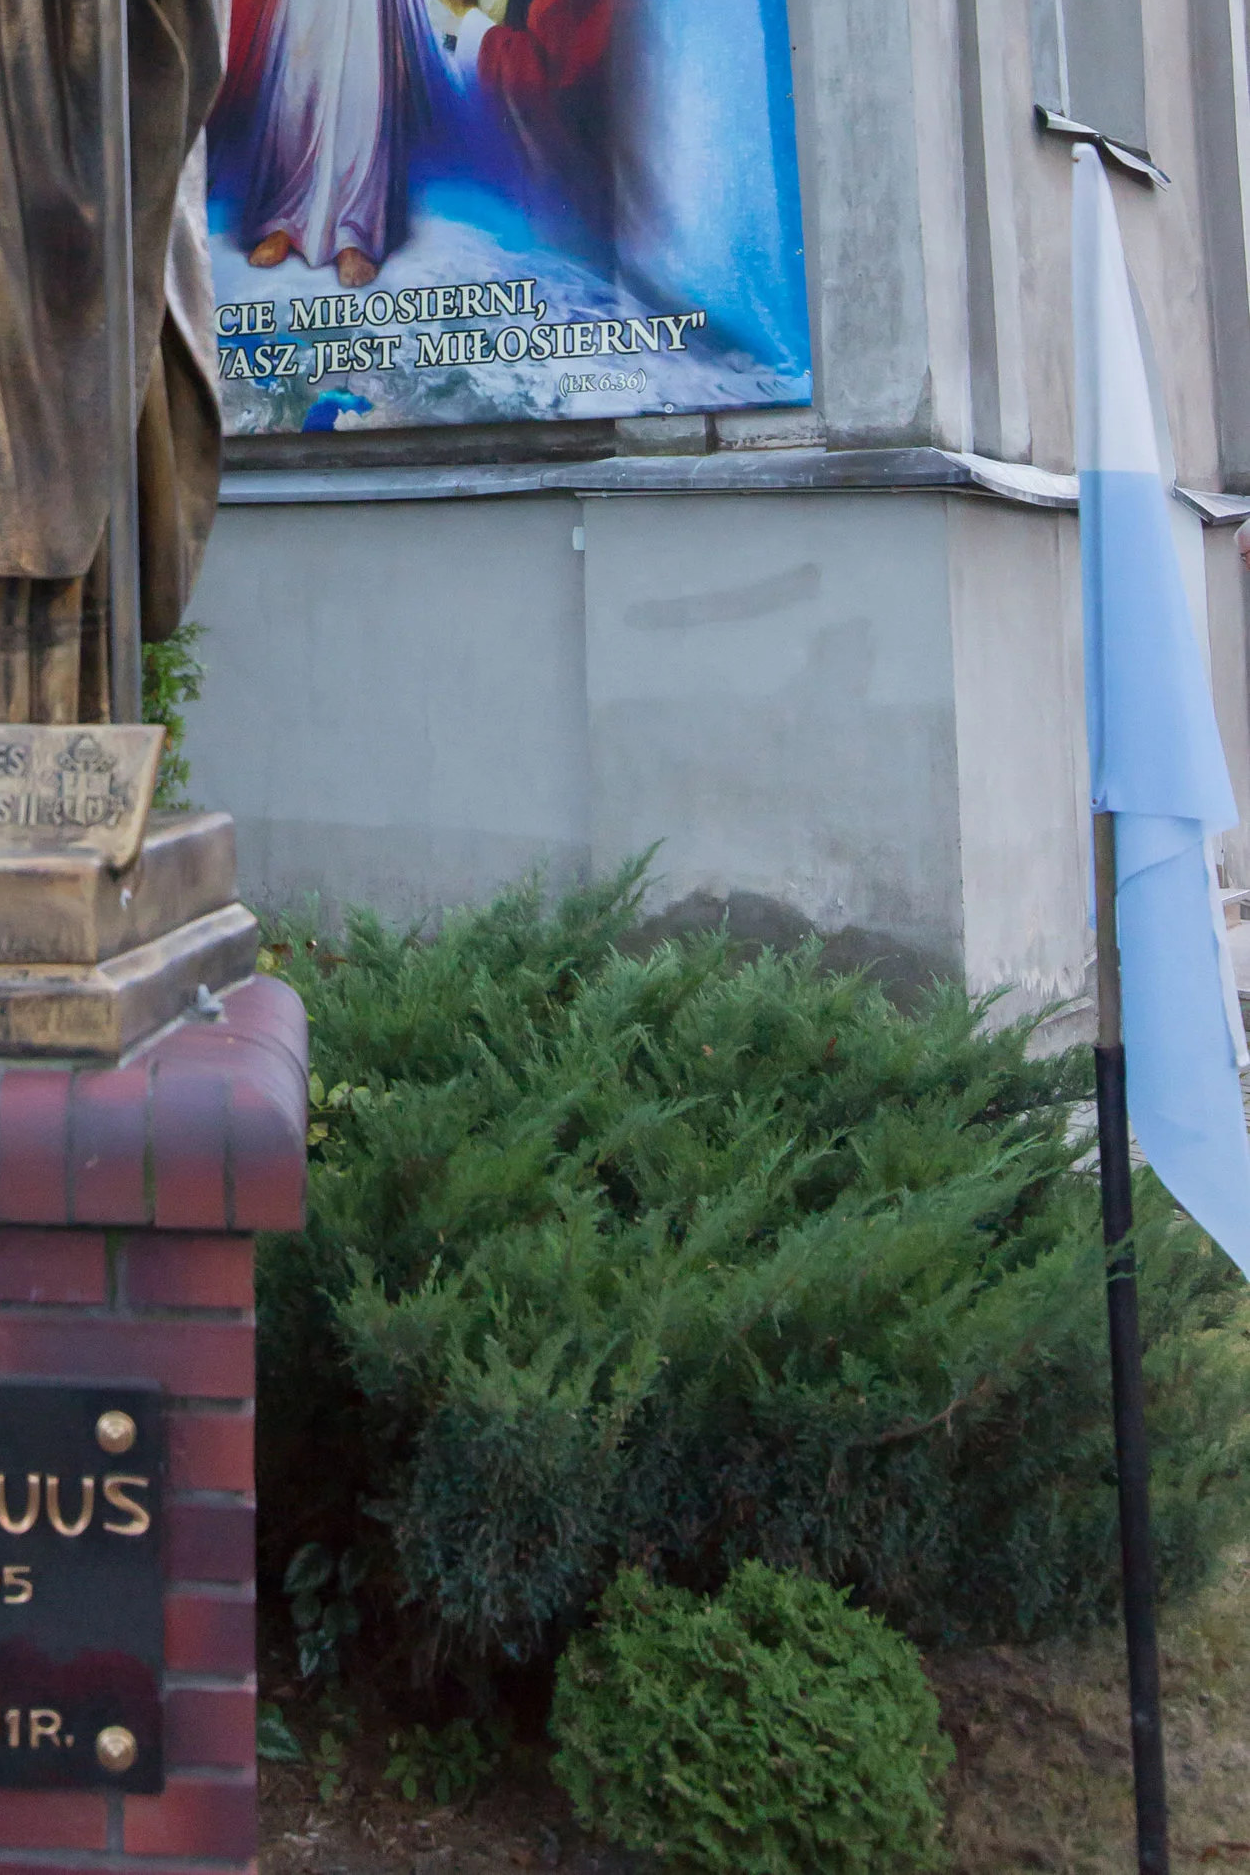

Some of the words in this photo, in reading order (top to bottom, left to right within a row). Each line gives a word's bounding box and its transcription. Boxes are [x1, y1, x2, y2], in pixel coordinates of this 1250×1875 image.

[289, 277, 549, 332] MIŁOSIERNI,
[307, 334, 402, 384] JEST
[599, 368, 648, 394] 6.36)
[17, 789, 39, 826] II
